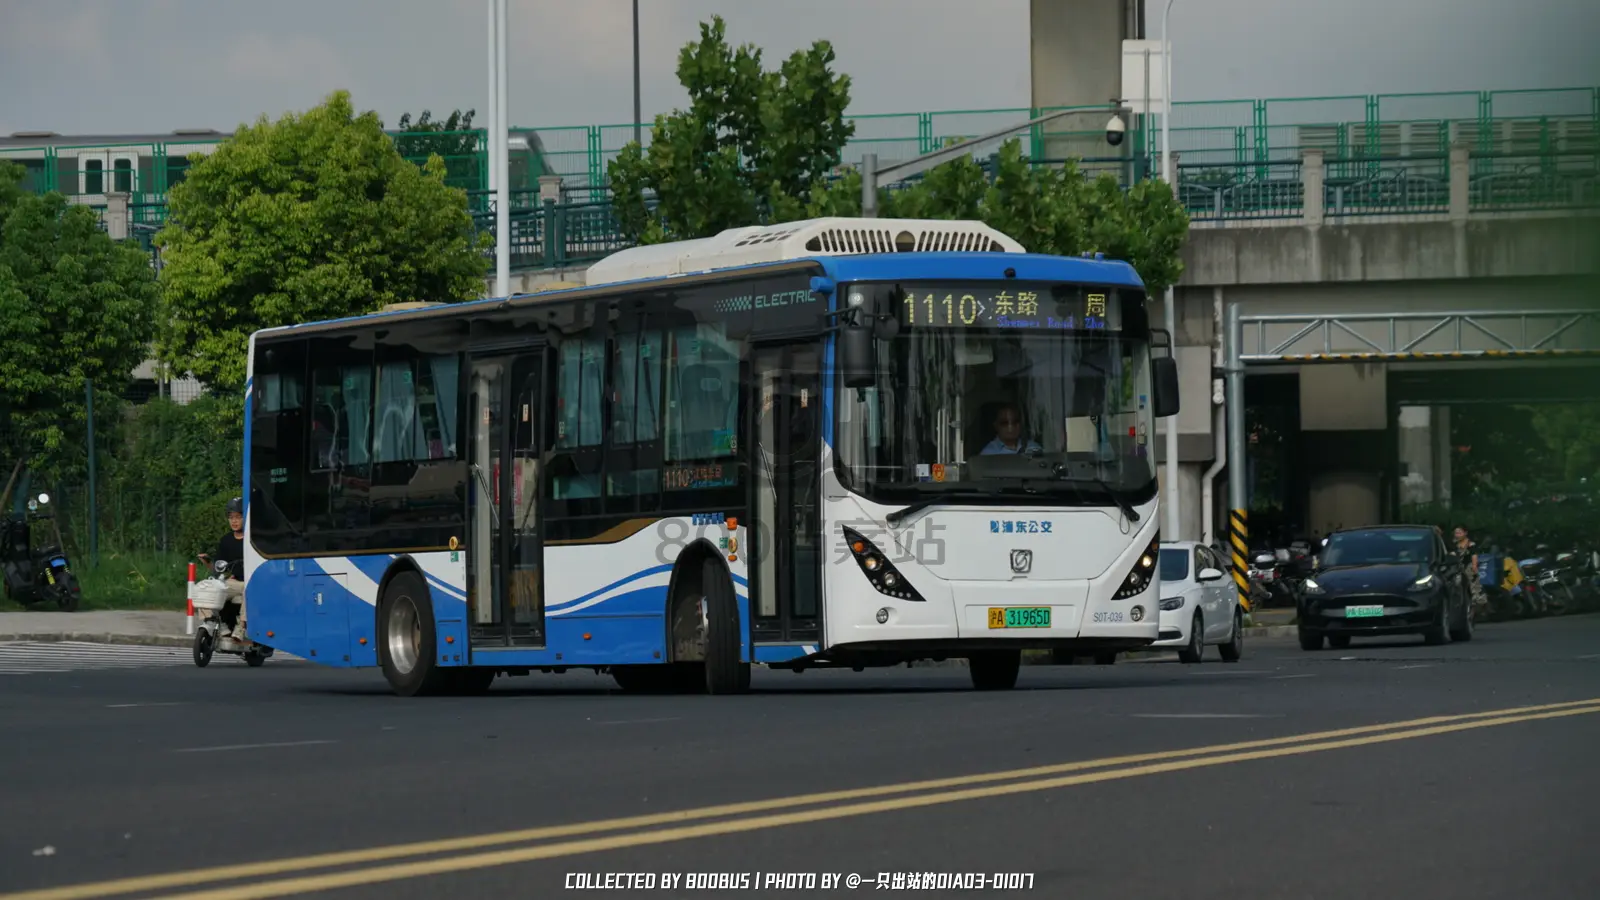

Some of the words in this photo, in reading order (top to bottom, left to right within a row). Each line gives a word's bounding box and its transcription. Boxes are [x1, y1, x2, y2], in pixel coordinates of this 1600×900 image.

[755, 289, 816, 309] ELECTRIC
[903, 293, 977, 325] 1110
[994, 290, 1039, 316] 东路
[1085, 293, 1106, 318] 周
[1002, 520, 1053, 534] 浦东公交
